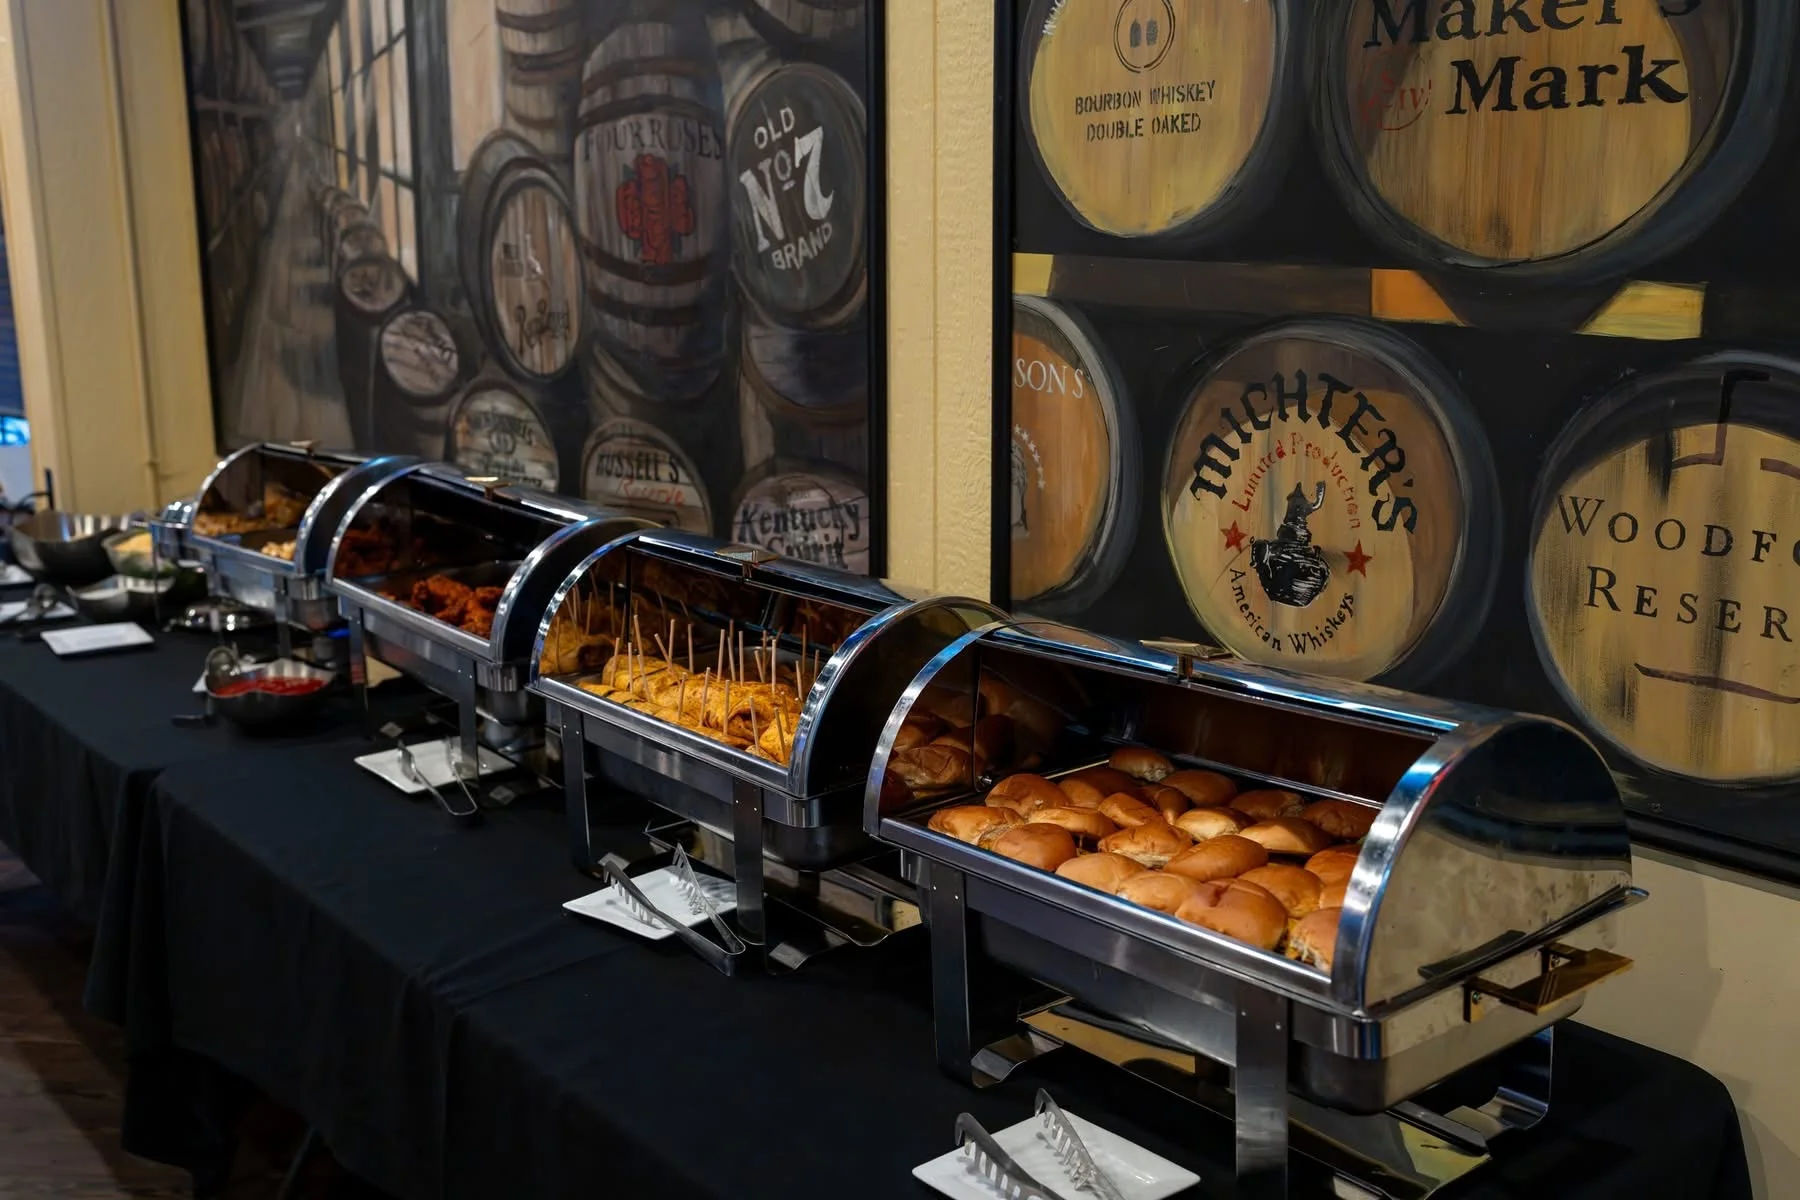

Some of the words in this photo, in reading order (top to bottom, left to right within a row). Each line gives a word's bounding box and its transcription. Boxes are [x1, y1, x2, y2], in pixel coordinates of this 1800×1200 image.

[1075, 90, 1141, 115] BOURBON
[1150, 80, 1216, 104] WHISKEY
[1445, 45, 1688, 114] Mark
[754, 107, 795, 149] OLD
[1087, 118, 1144, 141] DOUBLE
[1152, 113, 1201, 134] OAKED
[795, 126, 834, 220] 7
[771, 222, 833, 270] BRAND
[1189, 368, 1418, 534] MICHTER'S
[1291, 432, 1361, 529] Production
[738, 503, 859, 544] Kentucky
[1230, 568, 1282, 651] American
[1288, 593, 1354, 654] Whiskeys
